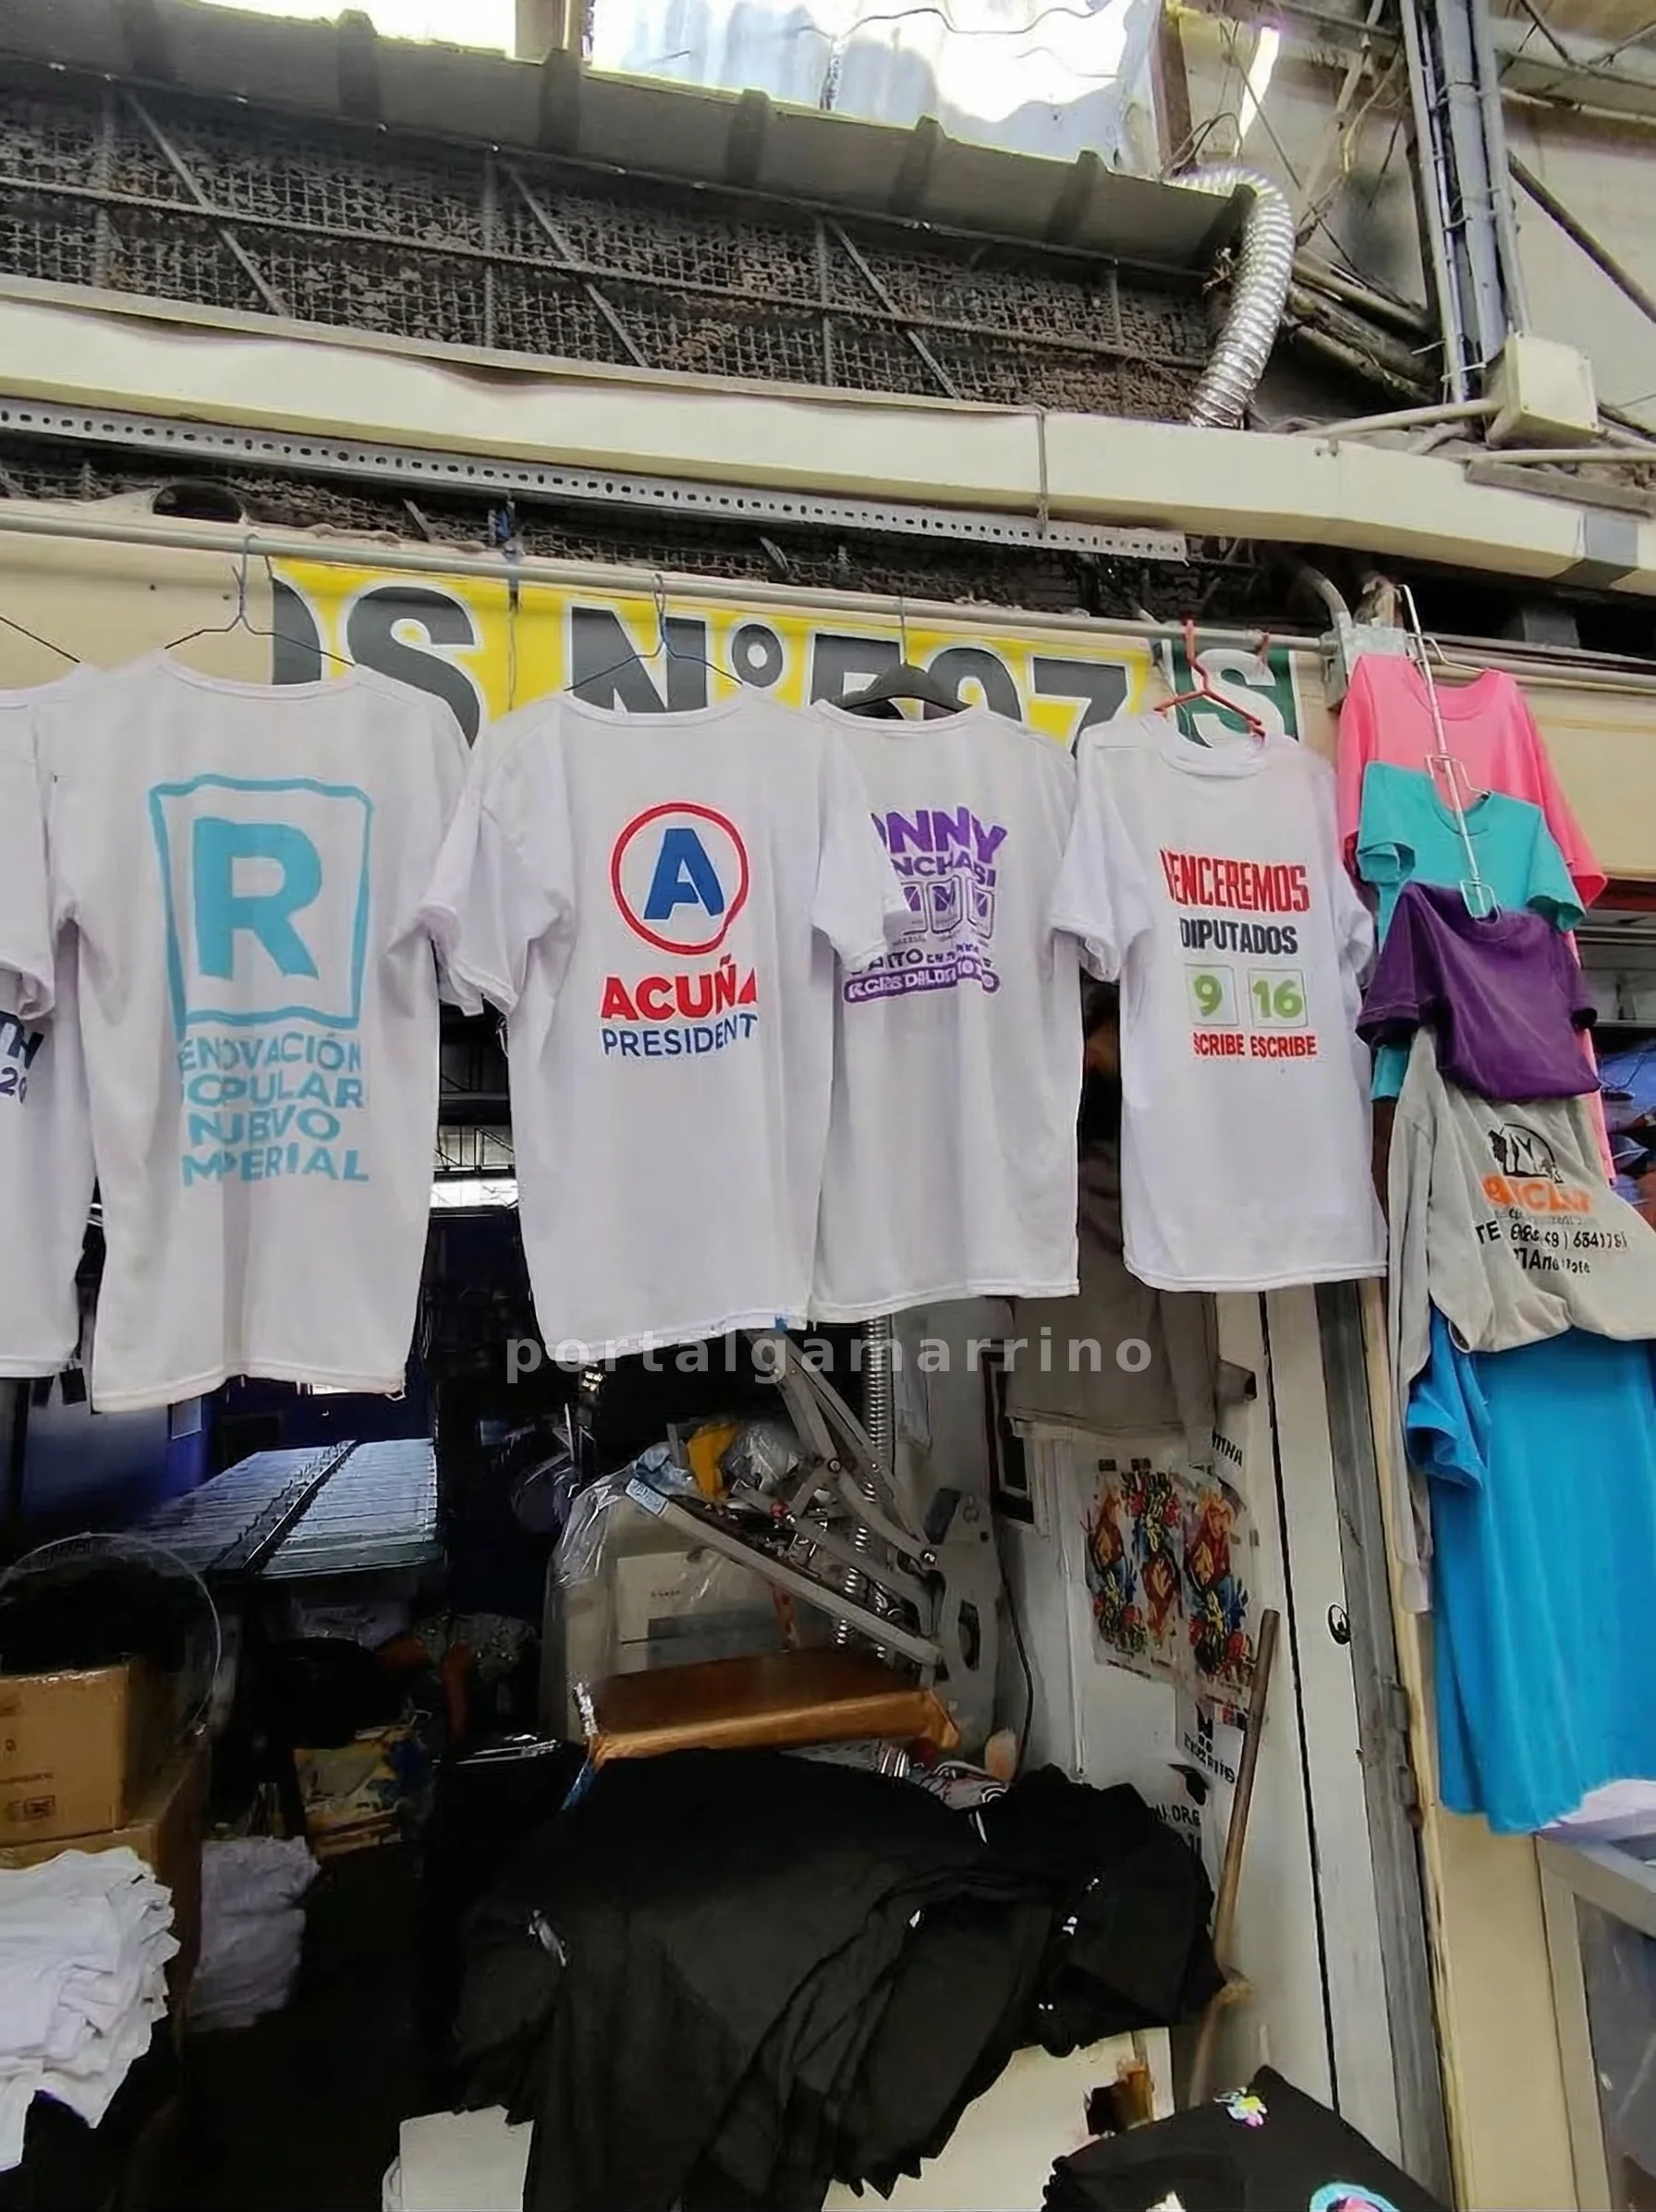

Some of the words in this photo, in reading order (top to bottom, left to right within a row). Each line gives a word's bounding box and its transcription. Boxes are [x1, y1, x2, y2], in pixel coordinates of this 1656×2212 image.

[871, 806, 1008, 864] NNY
[192, 817, 323, 979] R
[643, 827, 724, 920] A
[1179, 917, 1298, 955] DIPUTADOS
[1193, 974, 1224, 1017] 9
[1252, 978, 1304, 1019] 16
[1249, 1035, 1318, 1058] ESCRIBE
